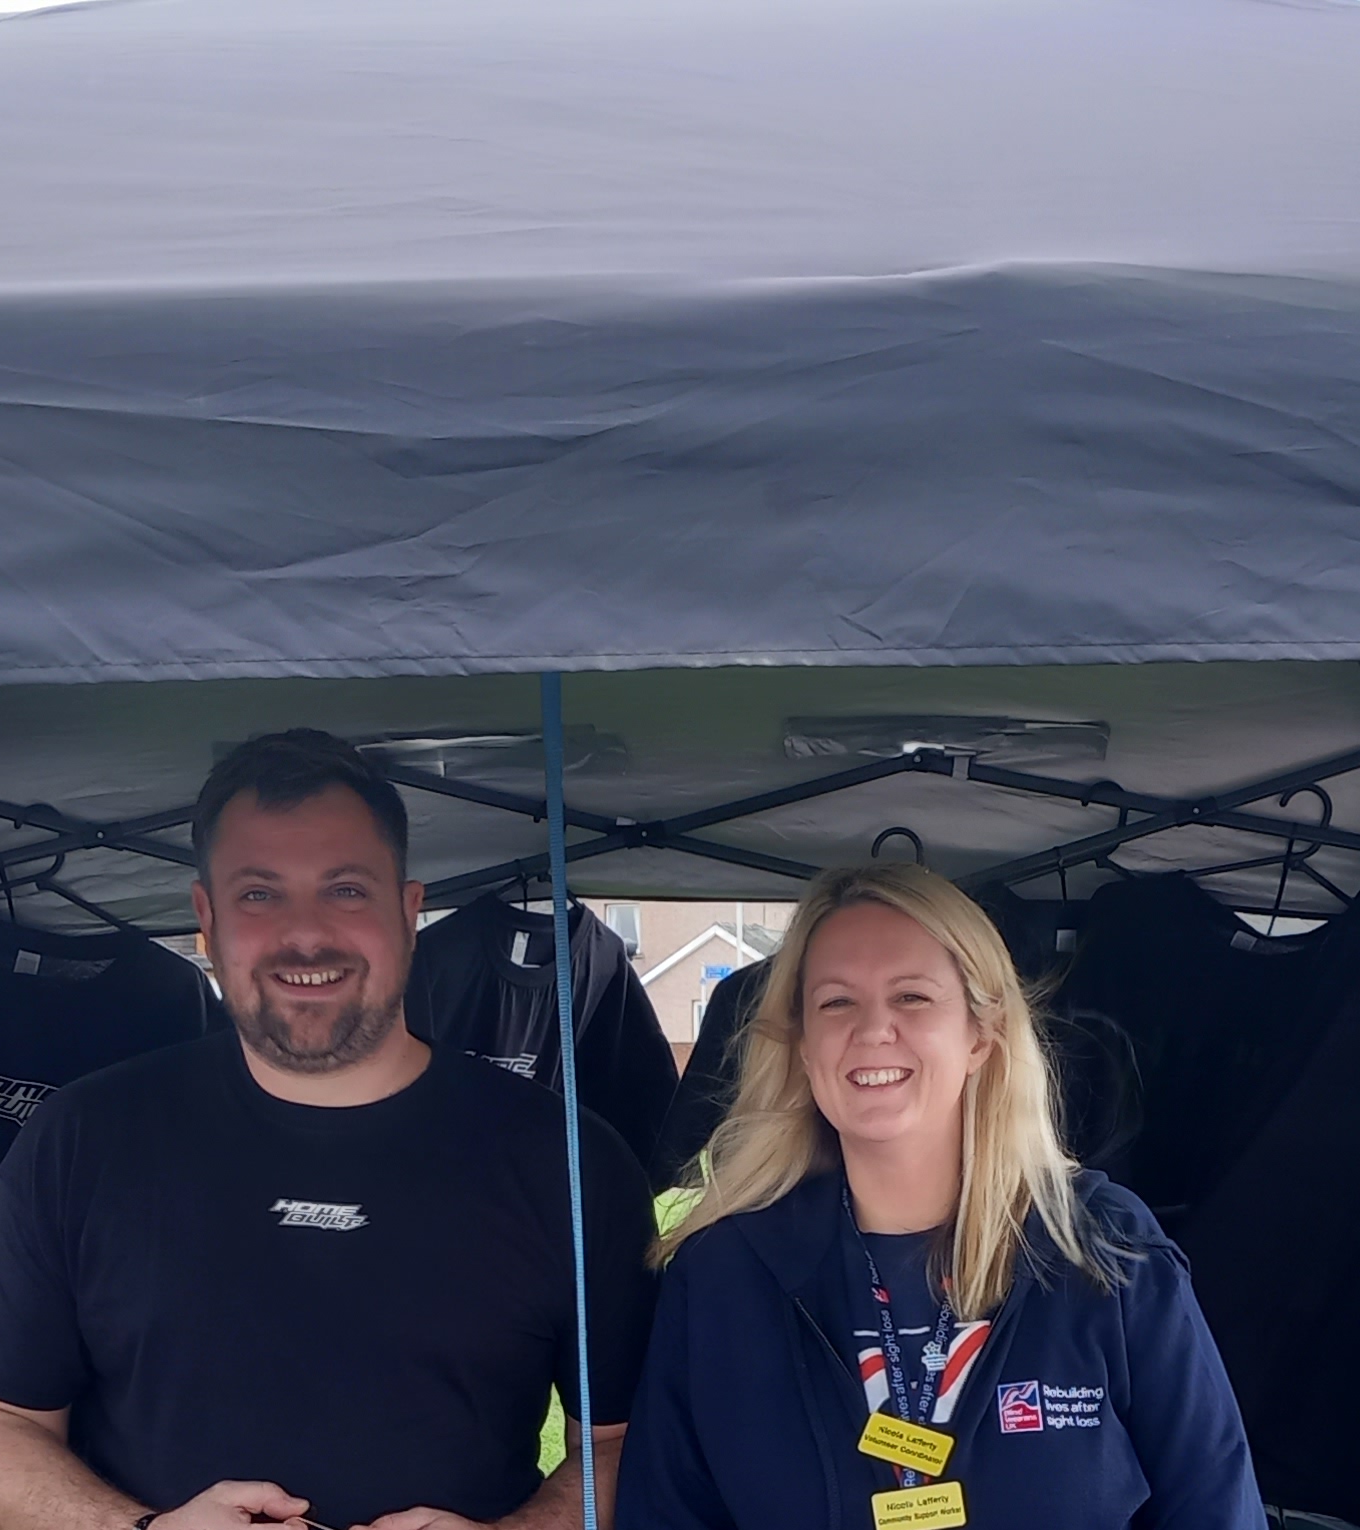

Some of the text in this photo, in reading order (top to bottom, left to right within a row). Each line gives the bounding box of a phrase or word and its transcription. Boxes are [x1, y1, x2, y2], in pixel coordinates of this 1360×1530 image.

[268, 1198, 363, 1216] HOME
[282, 1211, 369, 1230] BUILT
[881, 1309, 906, 1397] after sight loss
[1042, 1384, 1104, 1399] Rebuilding
[1044, 1399, 1100, 1413] lives after
[1046, 1415, 1101, 1429] sight loss
[878, 1426, 904, 1440] Nicola
[886, 1500, 914, 1512] Nicola
